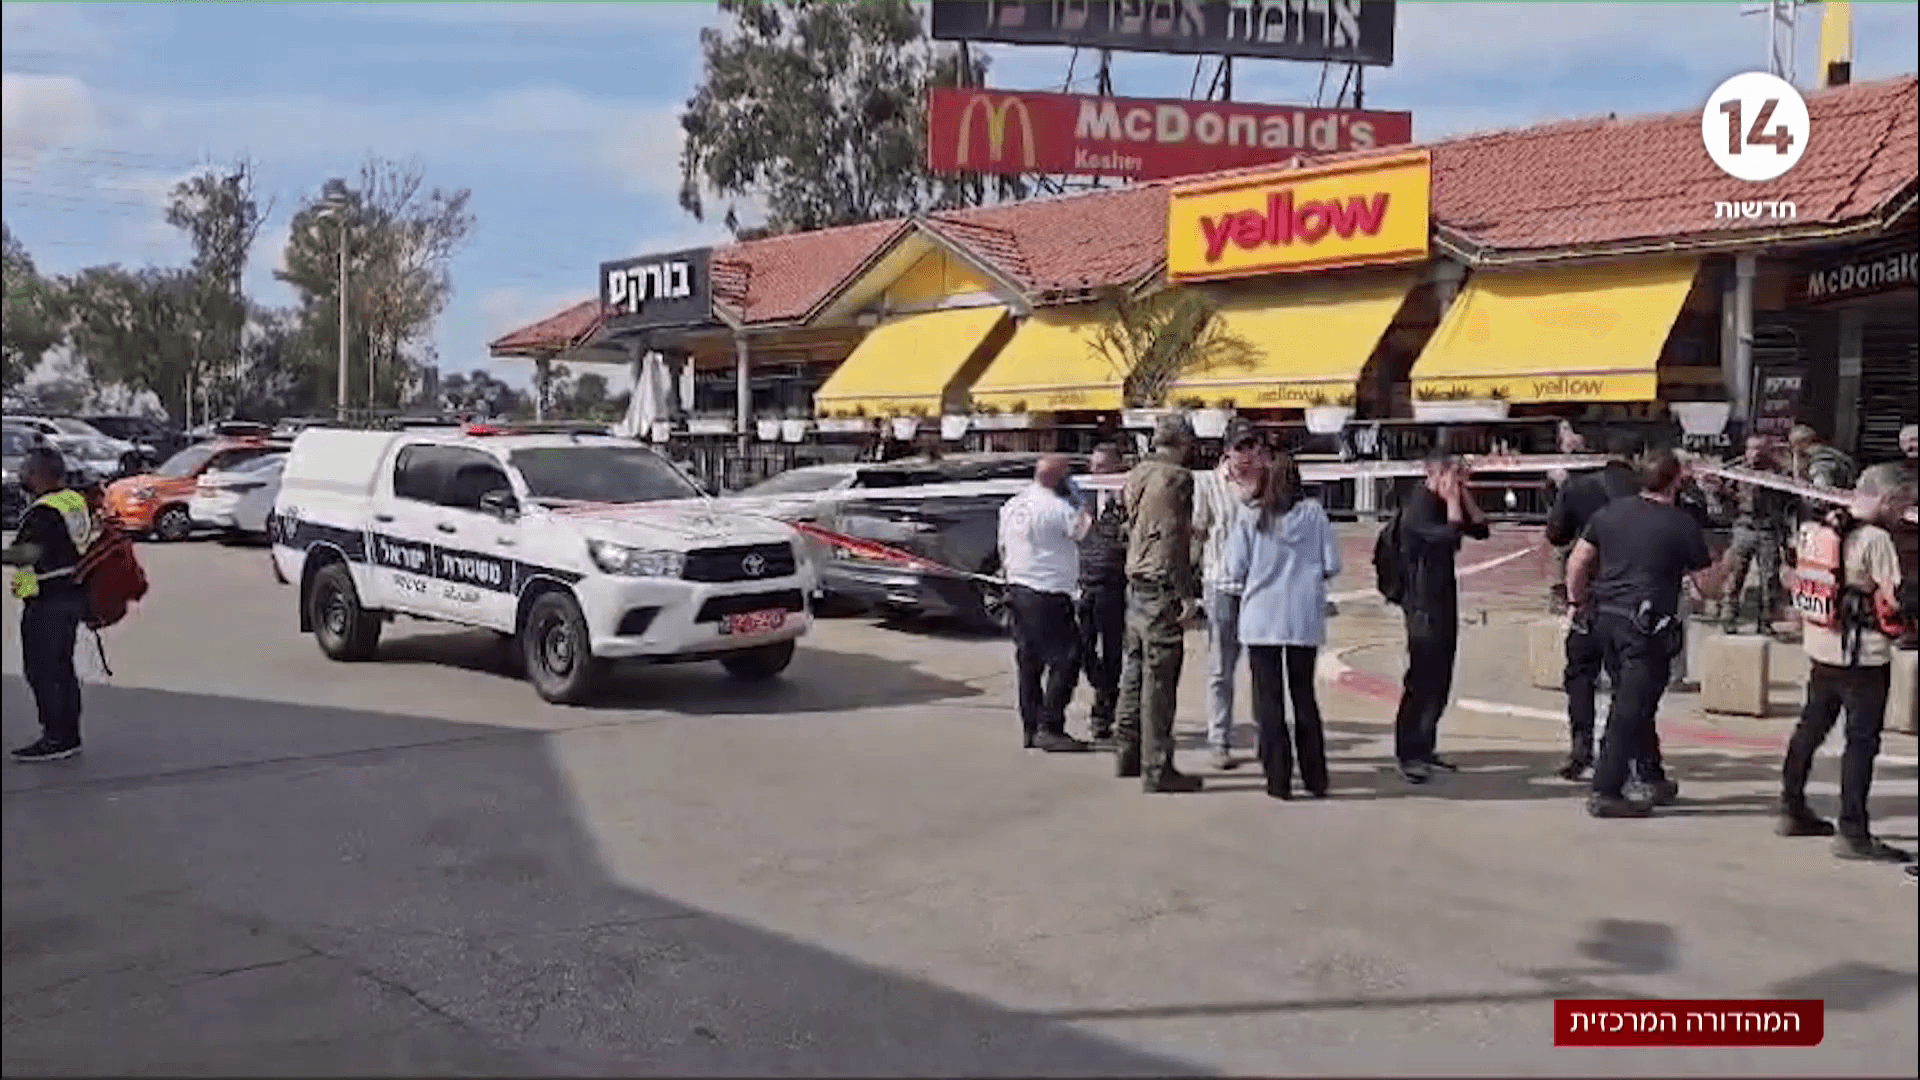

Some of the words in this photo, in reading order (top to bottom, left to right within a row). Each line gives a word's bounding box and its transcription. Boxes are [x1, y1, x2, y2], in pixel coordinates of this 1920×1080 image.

[1226, 0, 1361, 48] ארומה
[1074, 99, 1378, 150] McDonald's
[1073, 146, 1143, 171] Kosher
[1199, 188, 1391, 264] yellow
[608, 261, 691, 314] בורקס
[1532, 376, 1604, 399] yellow
[378, 538, 427, 569] ישראל
[440, 552, 502, 585] משטרת
